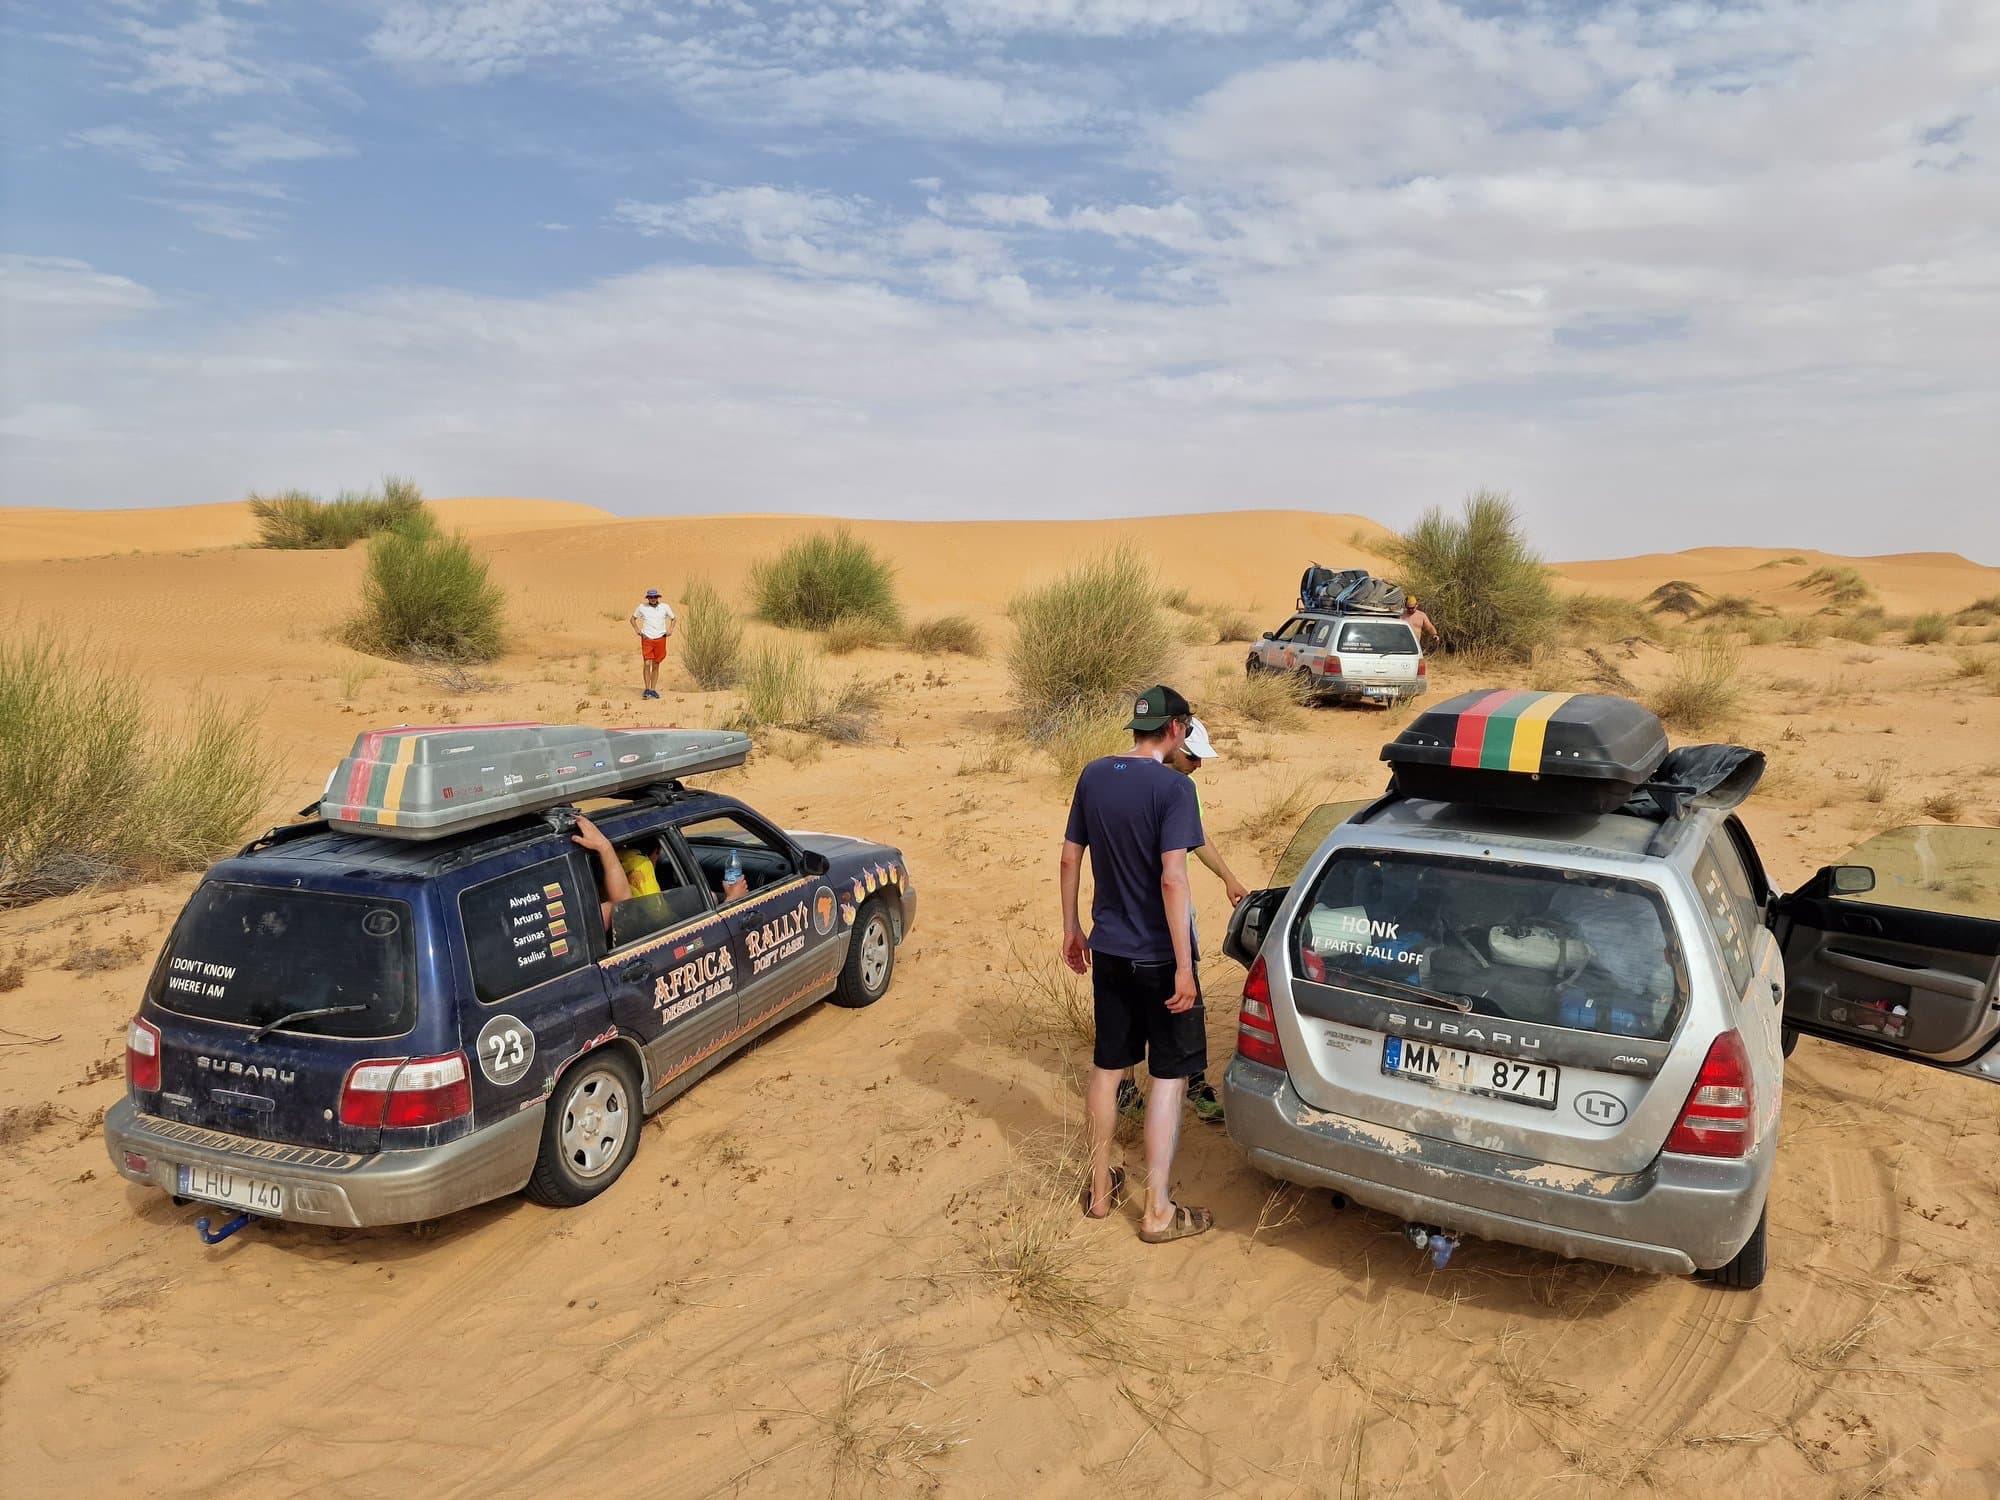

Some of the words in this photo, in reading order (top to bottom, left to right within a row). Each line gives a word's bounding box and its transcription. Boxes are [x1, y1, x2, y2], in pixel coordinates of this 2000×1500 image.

[509, 892, 540, 908] Alvydas
[369, 915, 393, 930] LT
[513, 911, 543, 927] Arturas
[1342, 916, 1400, 940] HONK
[517, 950, 547, 967] Saulius
[653, 945, 735, 1009] AFRICA
[745, 900, 809, 959] RALLY!
[1311, 936, 1322, 949] IF
[1324, 939, 1362, 955] PARTS
[1365, 945, 1394, 961] FALL
[1397, 951, 1424, 966] OFF
[169, 956, 175, 968] I
[174, 957, 204, 973] DON'T
[203, 963, 236, 979] KNOW
[169, 976, 201, 993] WHERE
[201, 982, 207, 995] I
[206, 984, 225, 999] AM
[662, 990, 706, 1026] DESERT
[1388, 1013, 1540, 1049] SUBARU
[488, 1029, 524, 1072] 23
[1613, 1055, 1648, 1065] AWD
[196, 1055, 295, 1082] SUBARU
[1387, 1055, 1399, 1065] LT
[1492, 1061, 1548, 1097] 871
[1585, 1097, 1616, 1119] LT
[192, 1168, 233, 1198] LHU
[248, 1180, 281, 1209] 140
